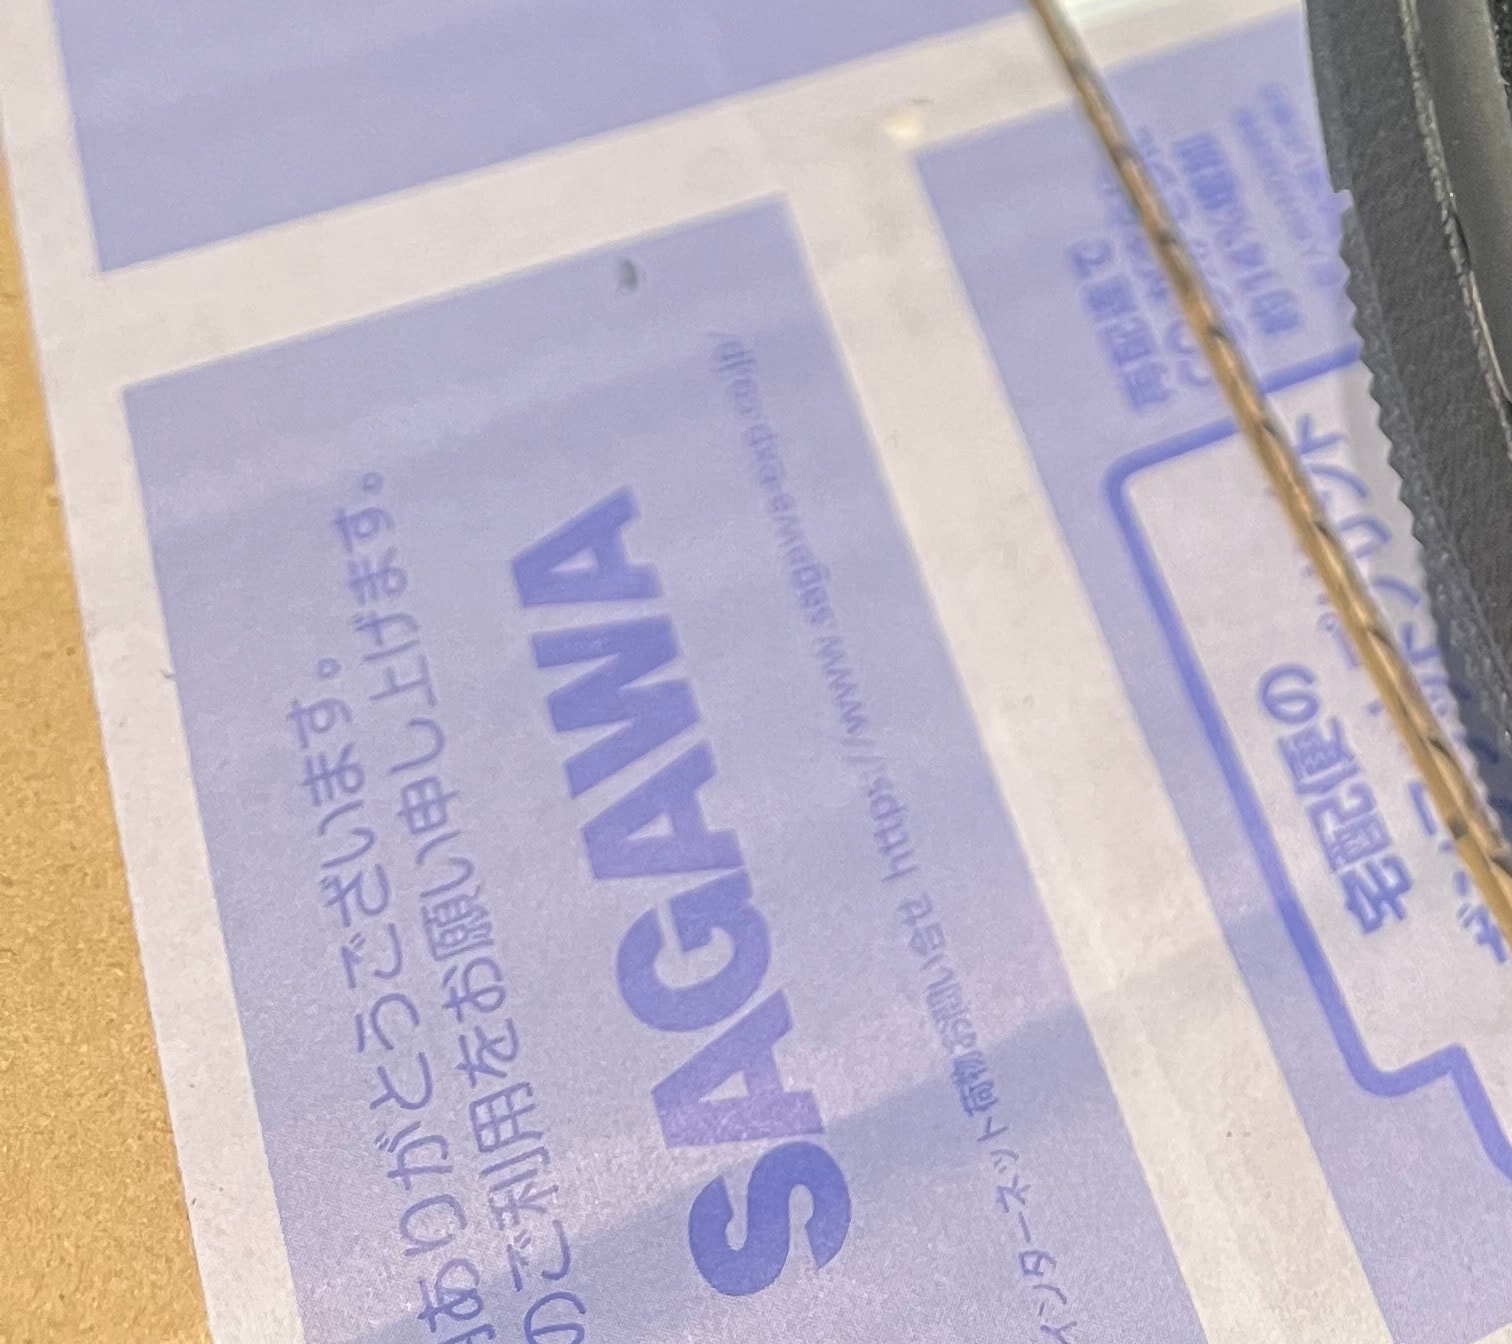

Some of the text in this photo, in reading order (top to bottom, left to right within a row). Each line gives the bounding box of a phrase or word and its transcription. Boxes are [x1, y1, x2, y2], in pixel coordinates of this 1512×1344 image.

[512, 487, 852, 1295] SAGAWA
[1258, 657, 1415, 936] 宅配便の
